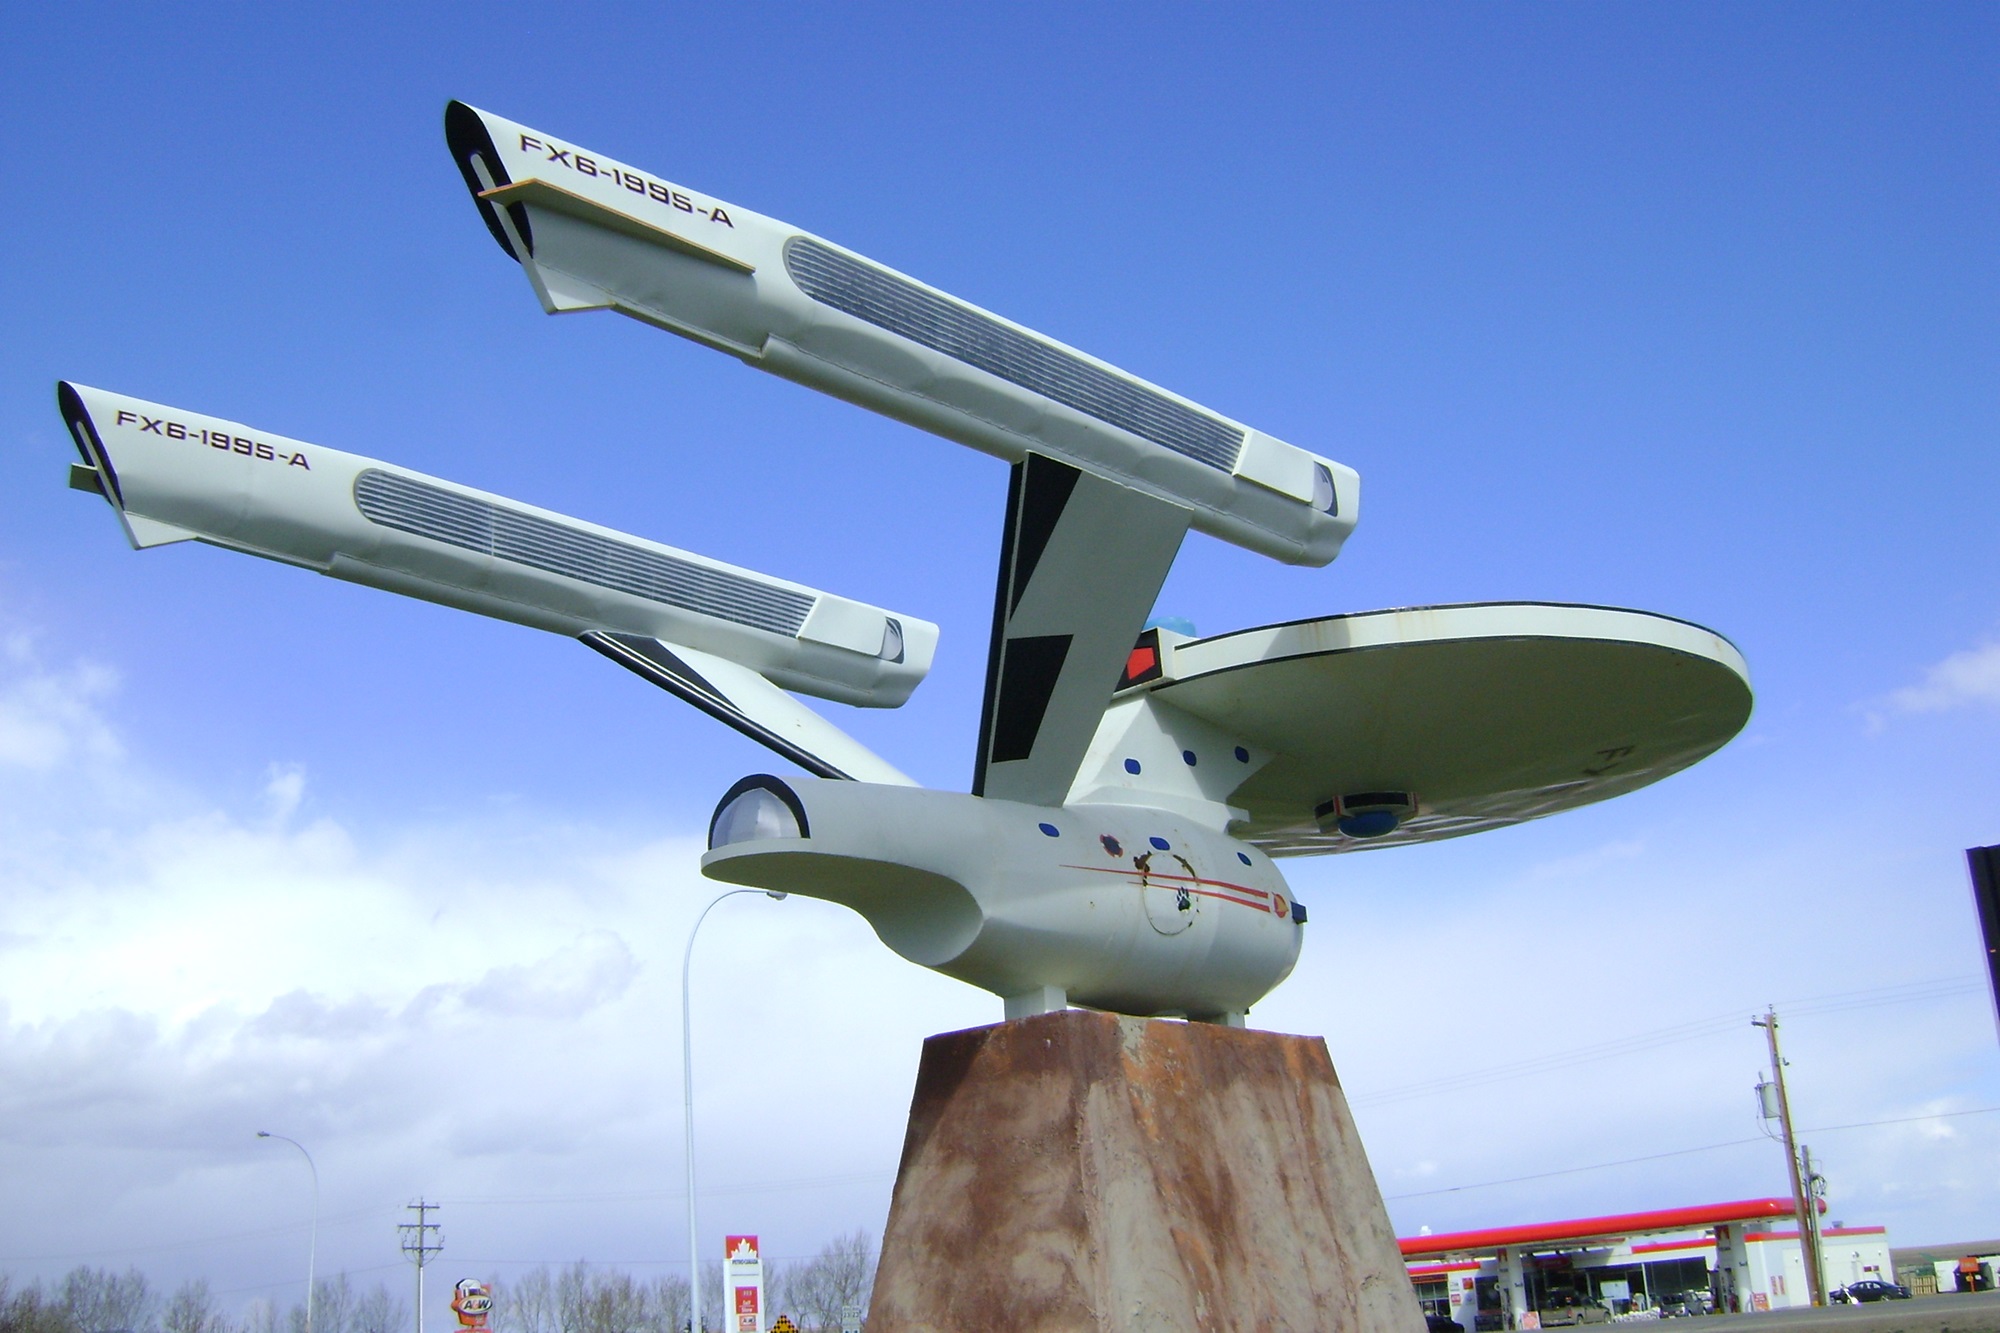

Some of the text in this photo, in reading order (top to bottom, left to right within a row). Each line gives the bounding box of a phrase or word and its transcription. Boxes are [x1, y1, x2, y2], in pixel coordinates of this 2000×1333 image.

[520, 133, 735, 229] FX6-1995-A
[116, 409, 311, 471] FX6-1995-A
[463, 1299, 490, 1310] A&W
